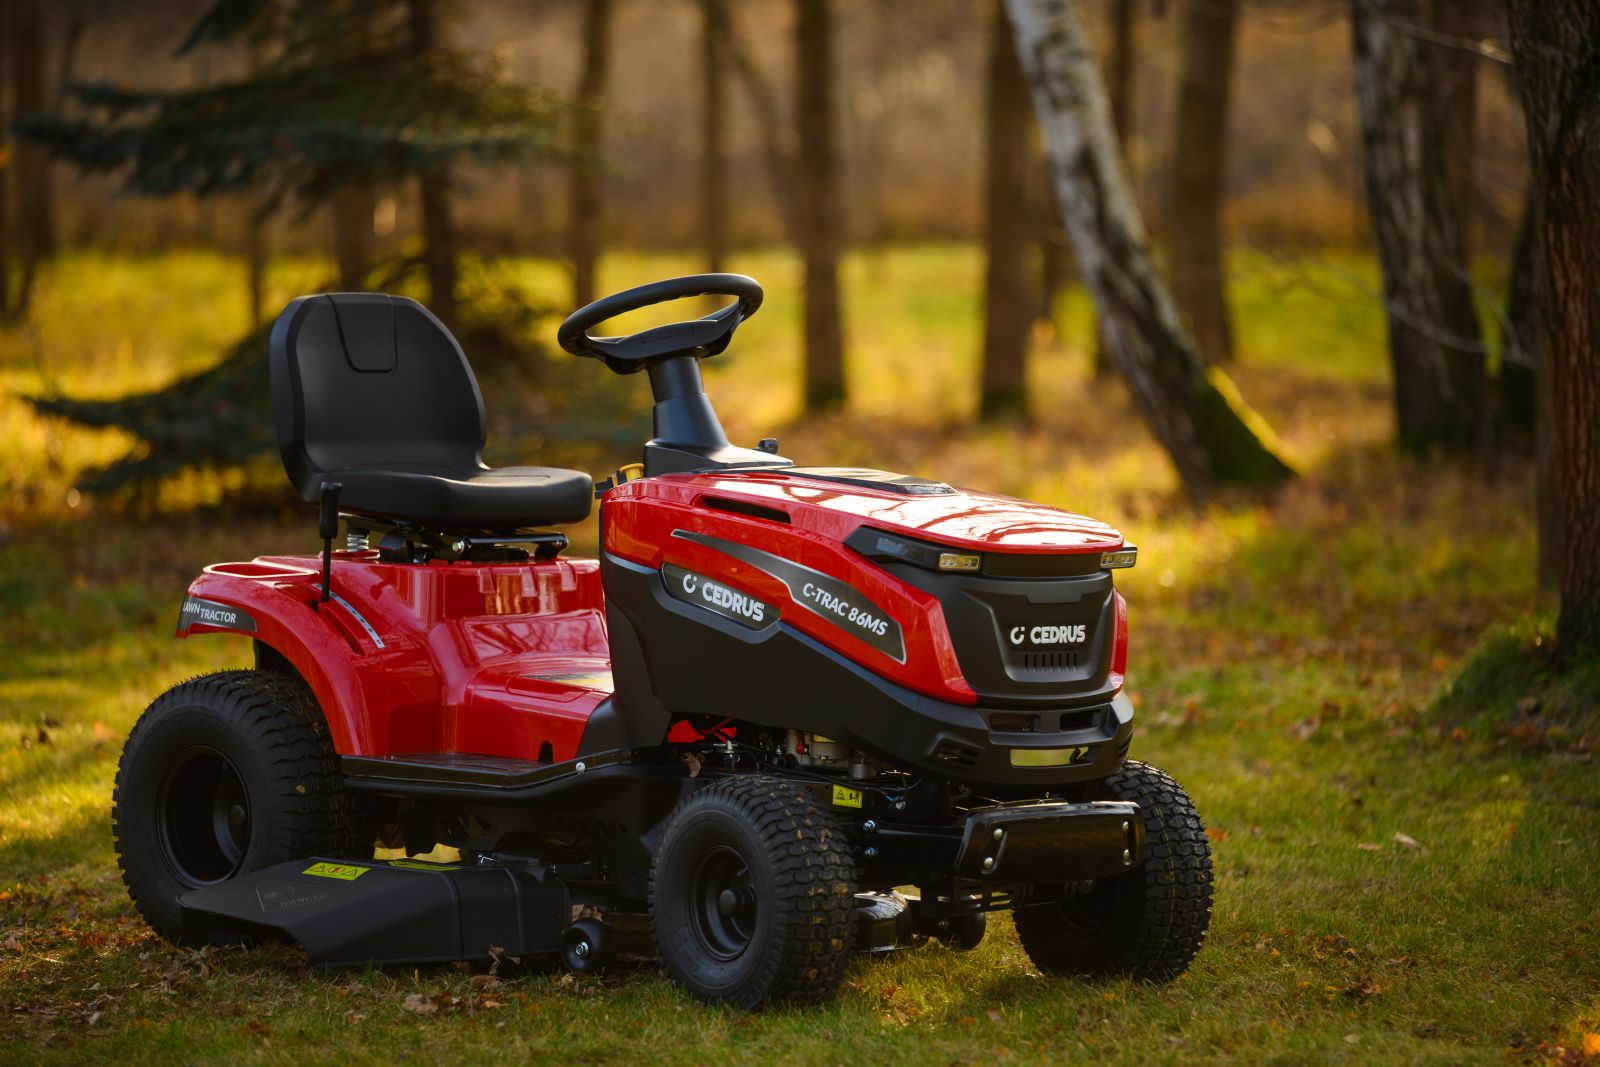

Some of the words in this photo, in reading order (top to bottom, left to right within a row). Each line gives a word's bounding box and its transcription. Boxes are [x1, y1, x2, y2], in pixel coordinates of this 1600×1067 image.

[200, 608, 237, 623] TRACTOR
[702, 582, 765, 622] CEDRUS
[803, 583, 849, 616] C-TRAC
[848, 607, 889, 636] 86MS
[1030, 625, 1086, 644] CEDRUS
